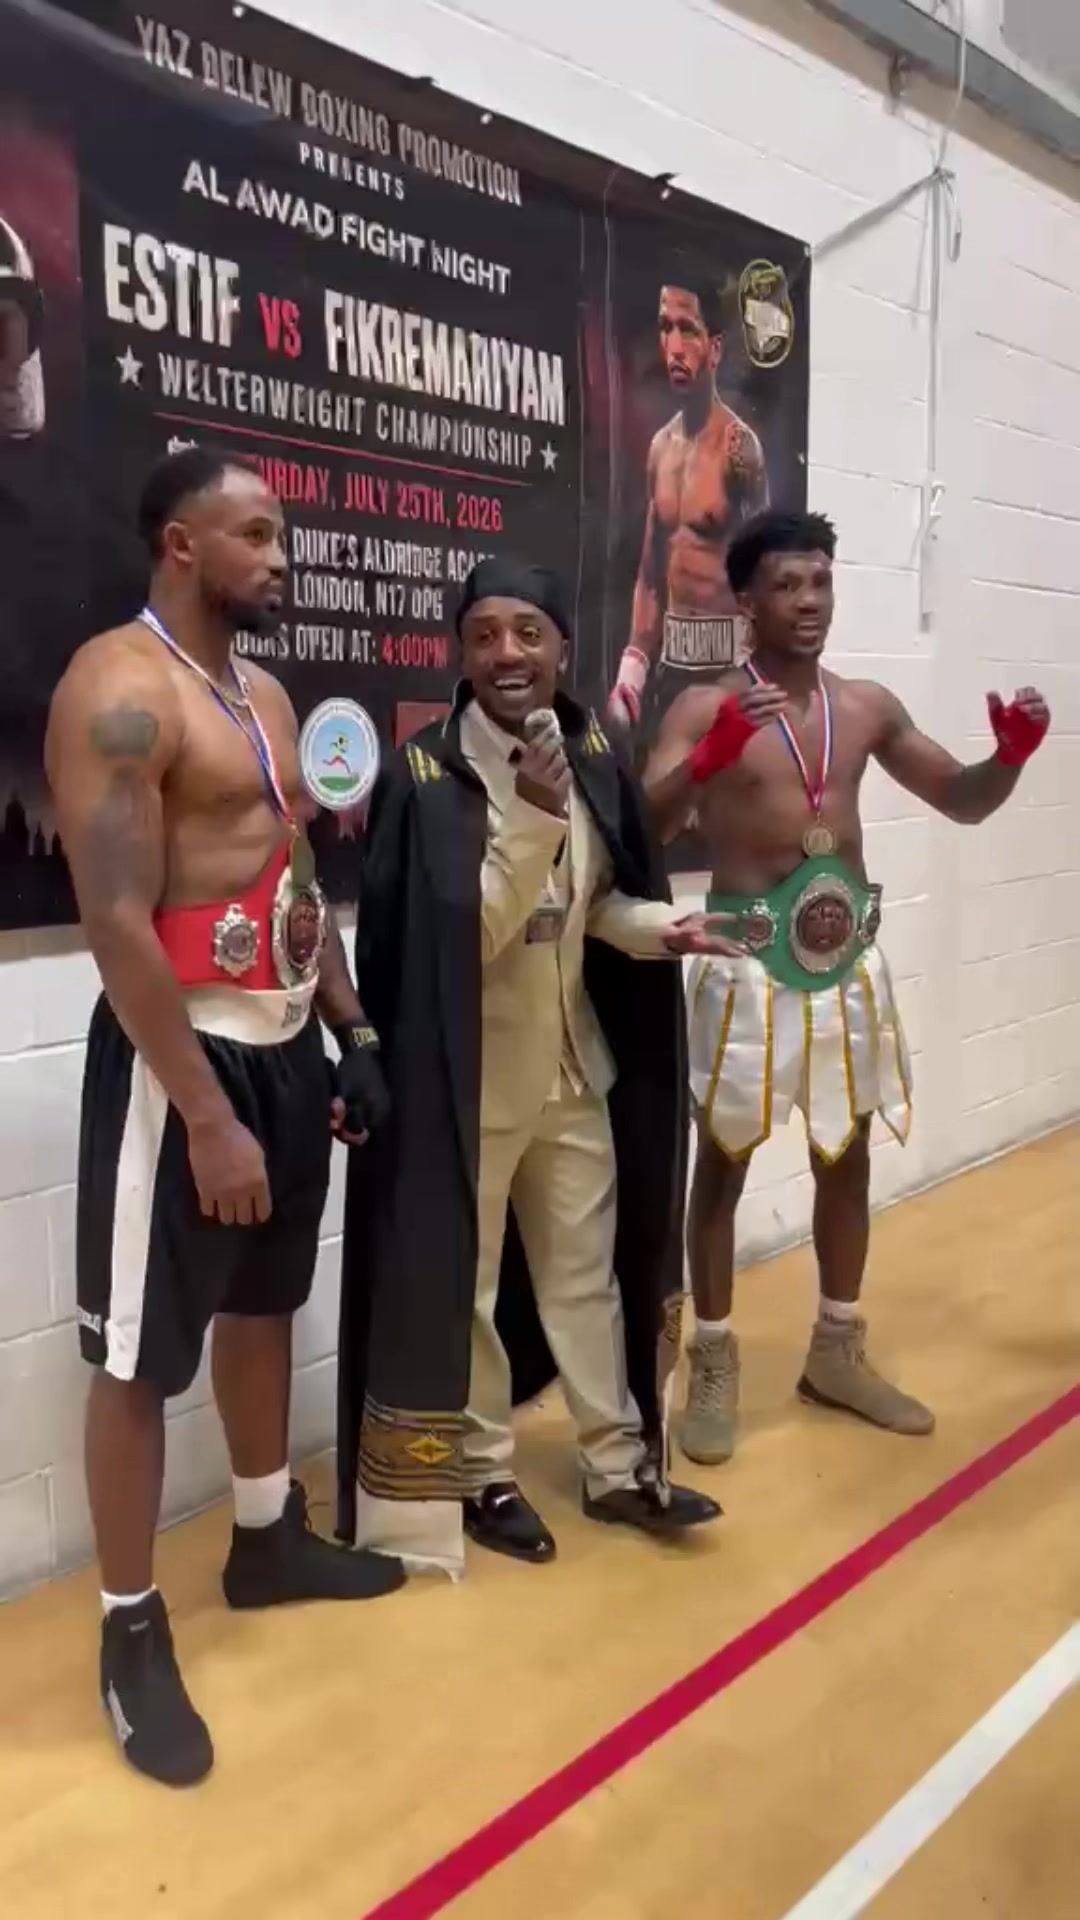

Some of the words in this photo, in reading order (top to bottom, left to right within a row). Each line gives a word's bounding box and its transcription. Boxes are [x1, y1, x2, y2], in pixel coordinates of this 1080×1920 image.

[134, 15, 193, 78] YAZ
[201, 41, 292, 118] DELEW
[301, 82, 390, 156] BOXING
[399, 123, 521, 205] PROMOTION
[299, 141, 405, 200] PRESENTS
[182, 160, 229, 204] AL
[236, 181, 335, 240] AWAD
[341, 213, 426, 268] FIGHT
[431, 240, 511, 295] NIGHT
[103, 223, 240, 348] ESTIF
[258, 293, 302, 359] VS
[324, 288, 566, 426] FIKREMARIYAM
[158, 352, 366, 437] WELTERWEIGHT
[376, 402, 532, 470] CHAMPIONSHIP
[254, 456, 337, 512] URDAY,
[344, 471, 389, 517] JULY
[397, 482, 451, 530] 25TH,
[456, 493, 504, 534] 2026
[292, 526, 358, 572] DUKE'S
[364, 535, 443, 581] ALDRIDGE
[293, 570, 371, 619] LONDON,
[375, 580, 406, 617] N17
[295, 624, 344, 662] OPEN
[351, 630, 377, 666] AT:
[381, 633, 448, 669] 4:00PM
